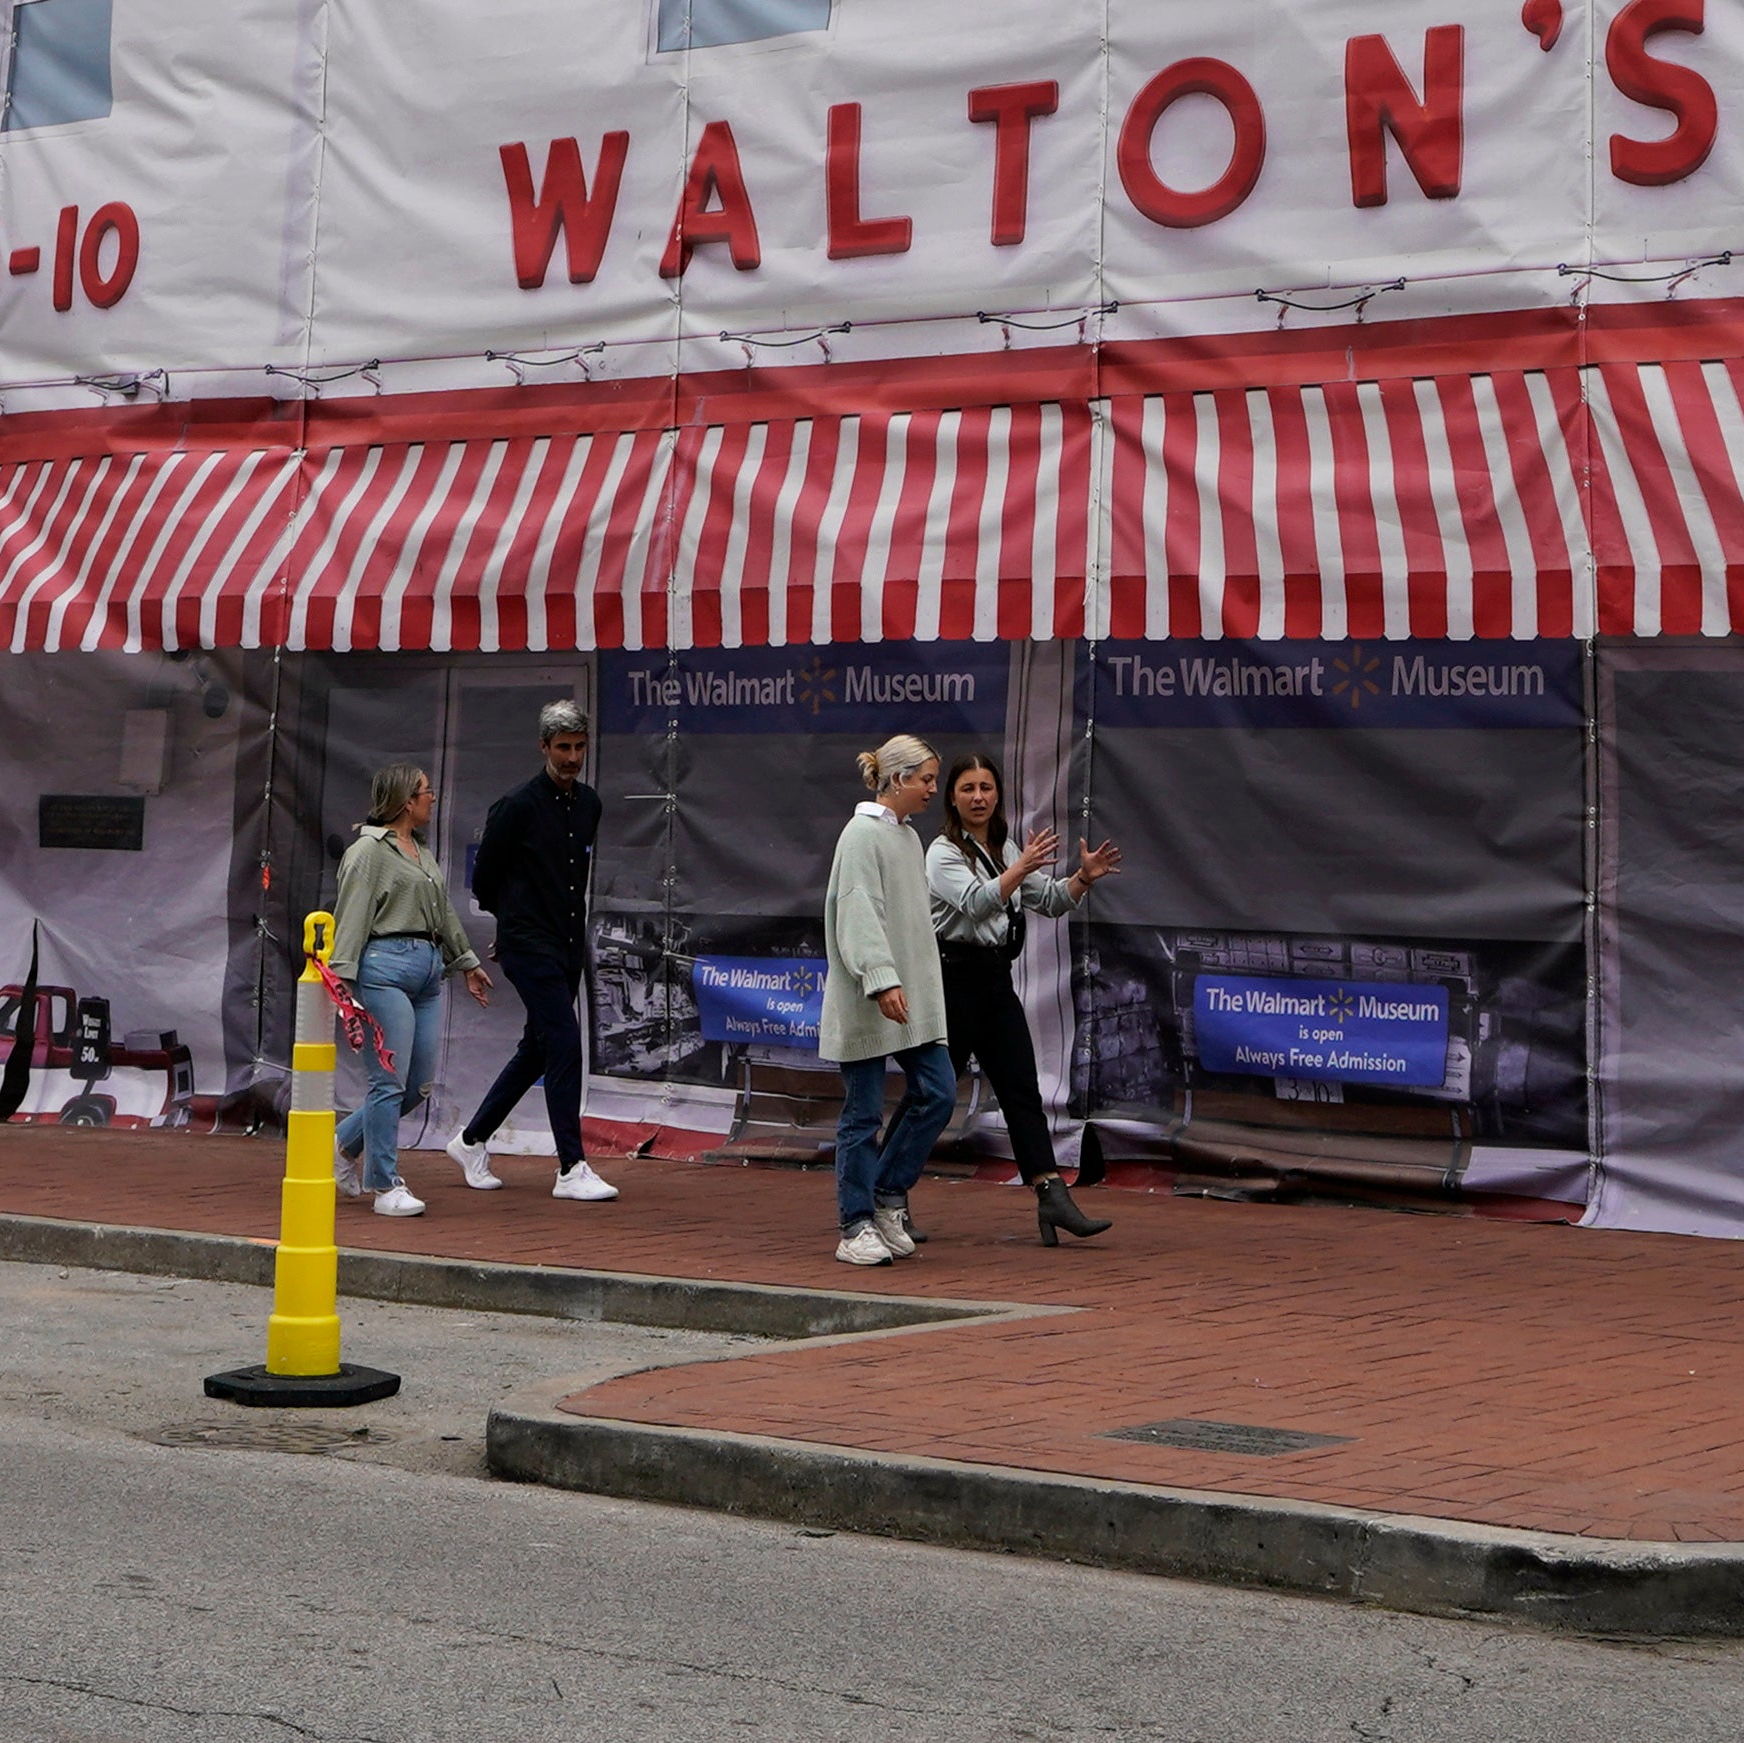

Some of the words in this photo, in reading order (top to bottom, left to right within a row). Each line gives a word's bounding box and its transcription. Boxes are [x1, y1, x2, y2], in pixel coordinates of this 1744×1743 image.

[628, 670, 681, 706] The
[685, 667, 795, 706] Walmart
[843, 665, 975, 704] Museum
[1108, 656, 1175, 697] The
[1178, 656, 1324, 697] Walmart
[1391, 654, 1545, 697] Museum
[702, 966, 729, 987] The
[730, 968, 791, 992] Walmart
[776, 1001, 804, 1015] open
[1206, 987, 1243, 1013] The
[1245, 992, 1325, 1017] Walmart
[1358, 996, 1439, 1022] Museum
[725, 1017, 760, 1038] Always
[761, 1018, 786, 1036] Free
[1298, 1024, 1309, 1040] is
[1312, 1028, 1344, 1045] open
[1235, 1046, 1285, 1070] Always
[1289, 1048, 1324, 1068] Free
[1326, 1050, 1407, 1073] Admission
